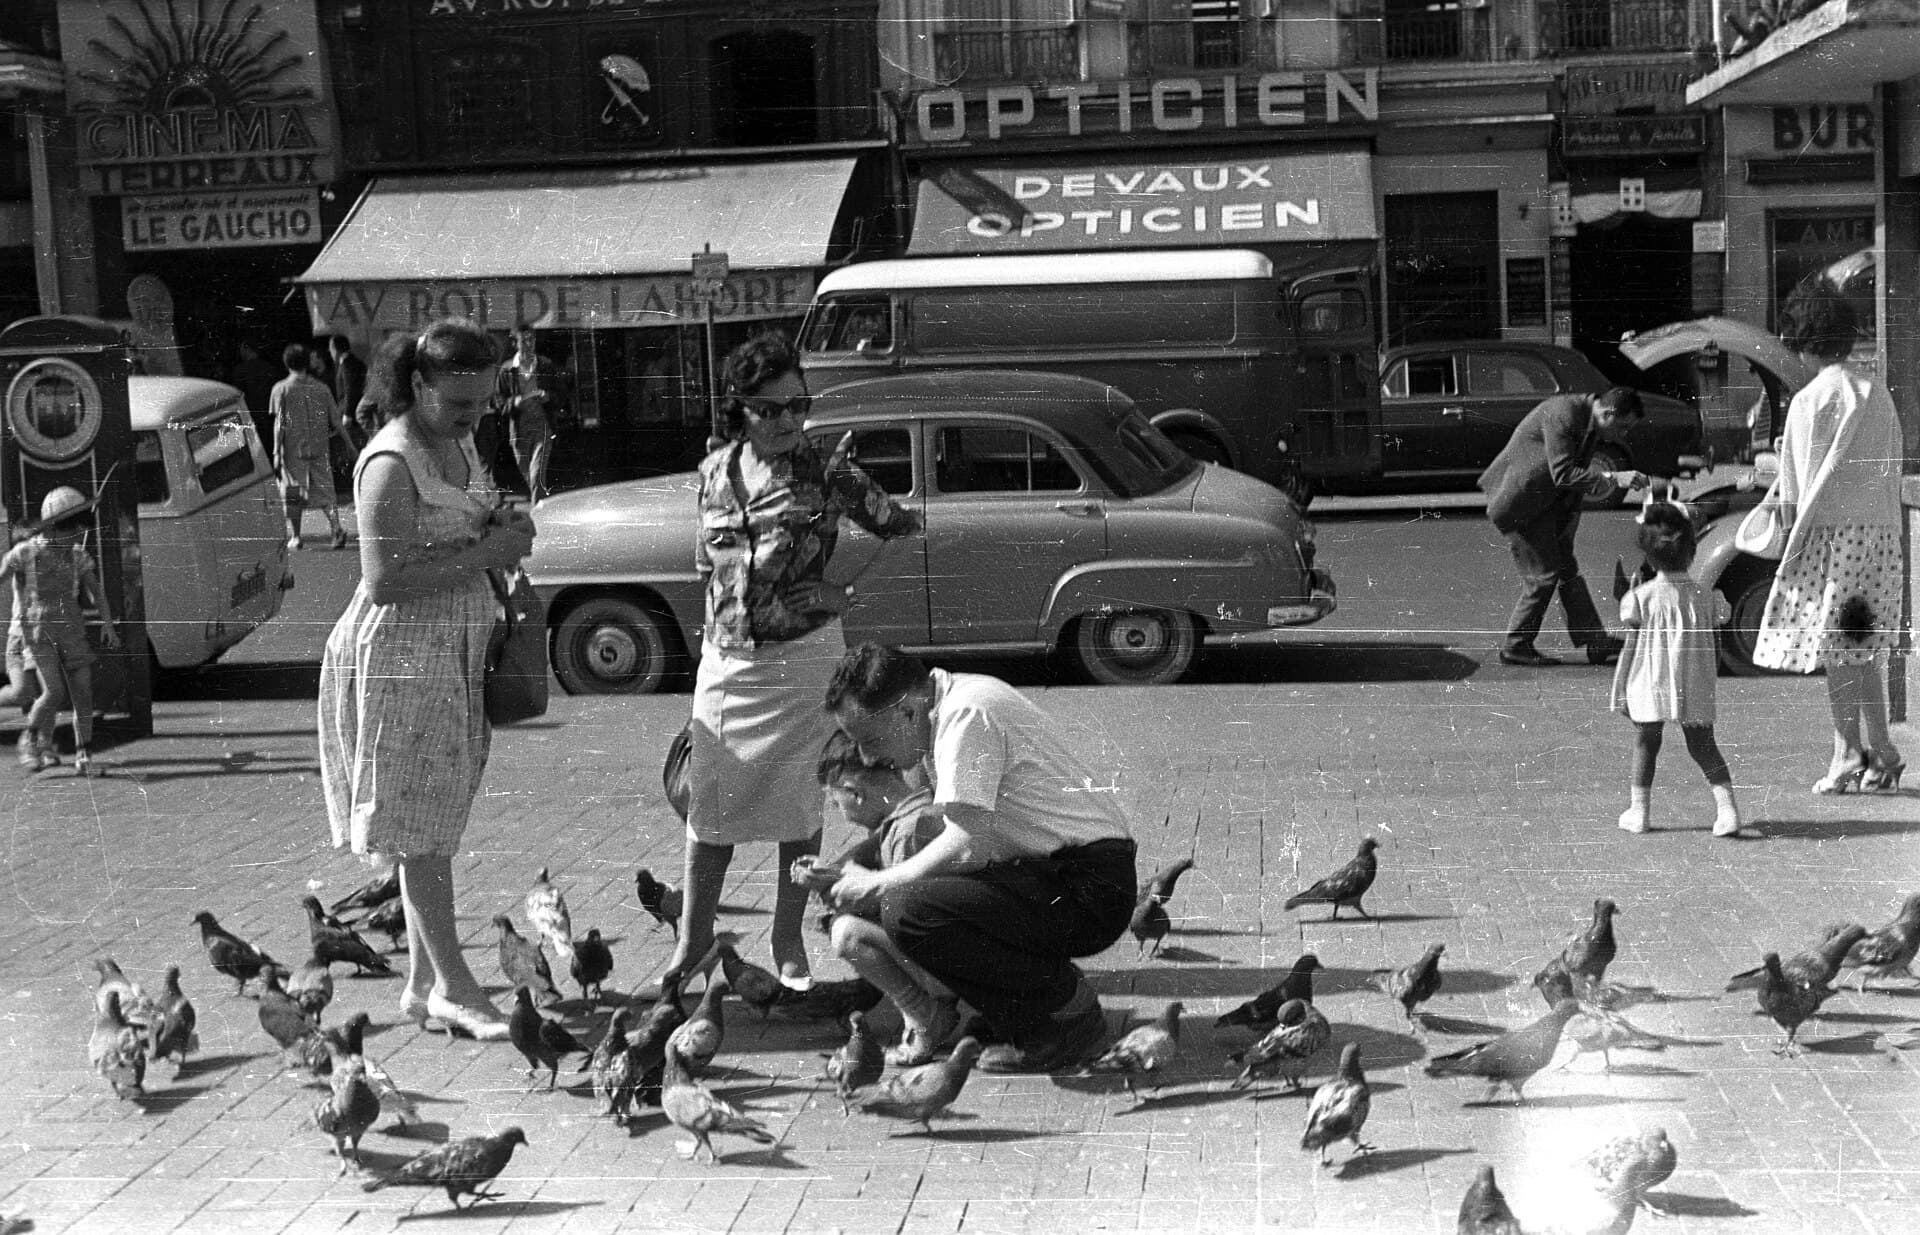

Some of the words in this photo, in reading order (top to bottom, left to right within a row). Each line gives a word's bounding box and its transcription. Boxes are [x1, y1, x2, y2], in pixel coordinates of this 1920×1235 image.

[917, 69, 1380, 143] OPTICIEN
[86, 107, 318, 160] CINEMA
[90, 154, 322, 192] TERREAUX
[1014, 165, 1274, 200] DEVAUX
[130, 216, 167, 245] LE
[180, 208, 312, 242] GAUCHO
[966, 199, 1321, 238] OPTICIEN
[328, 285, 387, 326] AV
[409, 287, 488, 326] ROI
[516, 286, 582, 328] DE
[611, 275, 800, 322] LAHORE
